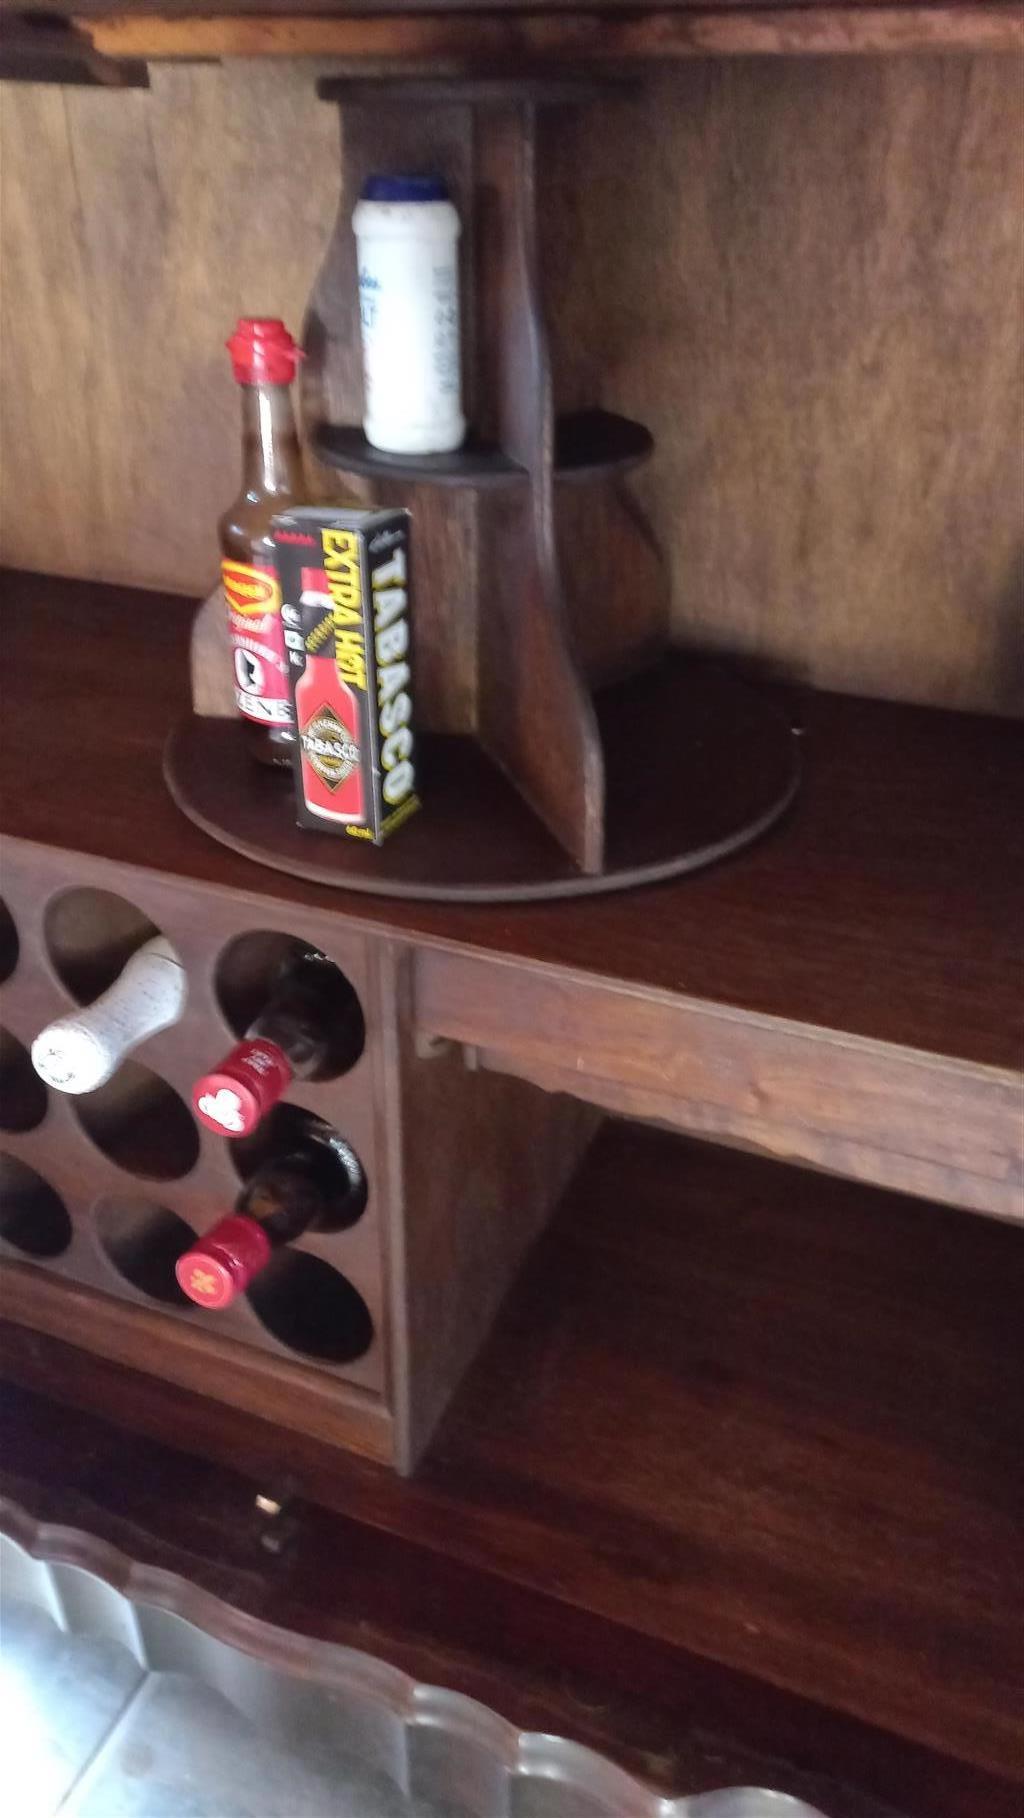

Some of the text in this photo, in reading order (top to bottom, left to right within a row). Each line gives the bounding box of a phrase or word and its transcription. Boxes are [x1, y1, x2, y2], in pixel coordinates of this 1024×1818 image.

[321, 528, 369, 691] EXTRA HOT
[372, 546, 416, 806] TABASCO
[301, 735, 360, 763] TABASCO
